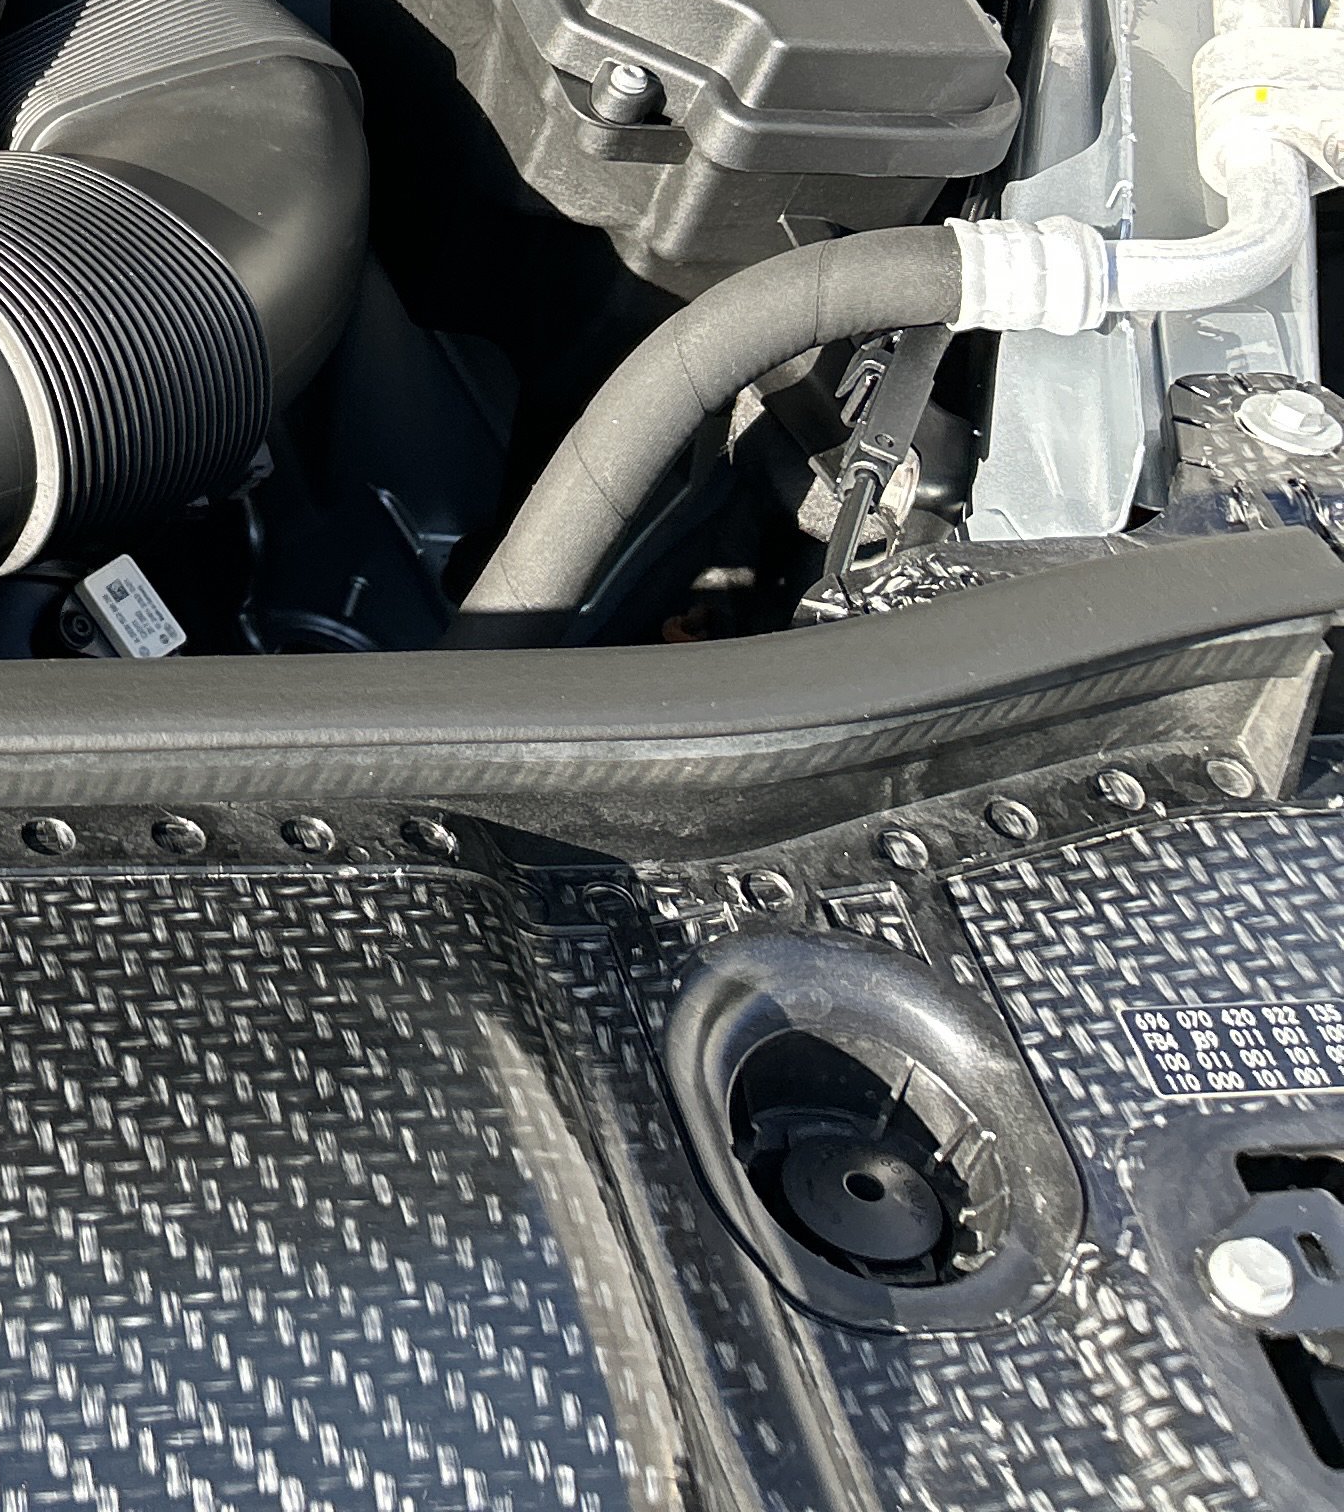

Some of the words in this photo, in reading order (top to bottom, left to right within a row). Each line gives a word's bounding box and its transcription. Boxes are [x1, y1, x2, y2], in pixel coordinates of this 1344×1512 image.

[1136, 1012, 1170, 1030] 696
[1176, 1010, 1213, 1029] 070
[1221, 1008, 1256, 1027] 420
[1261, 1006, 1300, 1025] 922
[1306, 1004, 1342, 1023] 135
[1142, 1032, 1179, 1051] FB4
[1229, 1028, 1266, 1047] 011
[1272, 1026, 1310, 1045] 001
[1155, 1053, 1191, 1072] 100
[1196, 1051, 1233, 1070] 011
[1239, 1049, 1277, 1068] 001
[1285, 1046, 1320, 1065] 101
[1165, 1074, 1202, 1093] 110
[1208, 1071, 1245, 1090] 000
[1252, 1068, 1288, 1088] 101
[1293, 1067, 1332, 1086] 001
